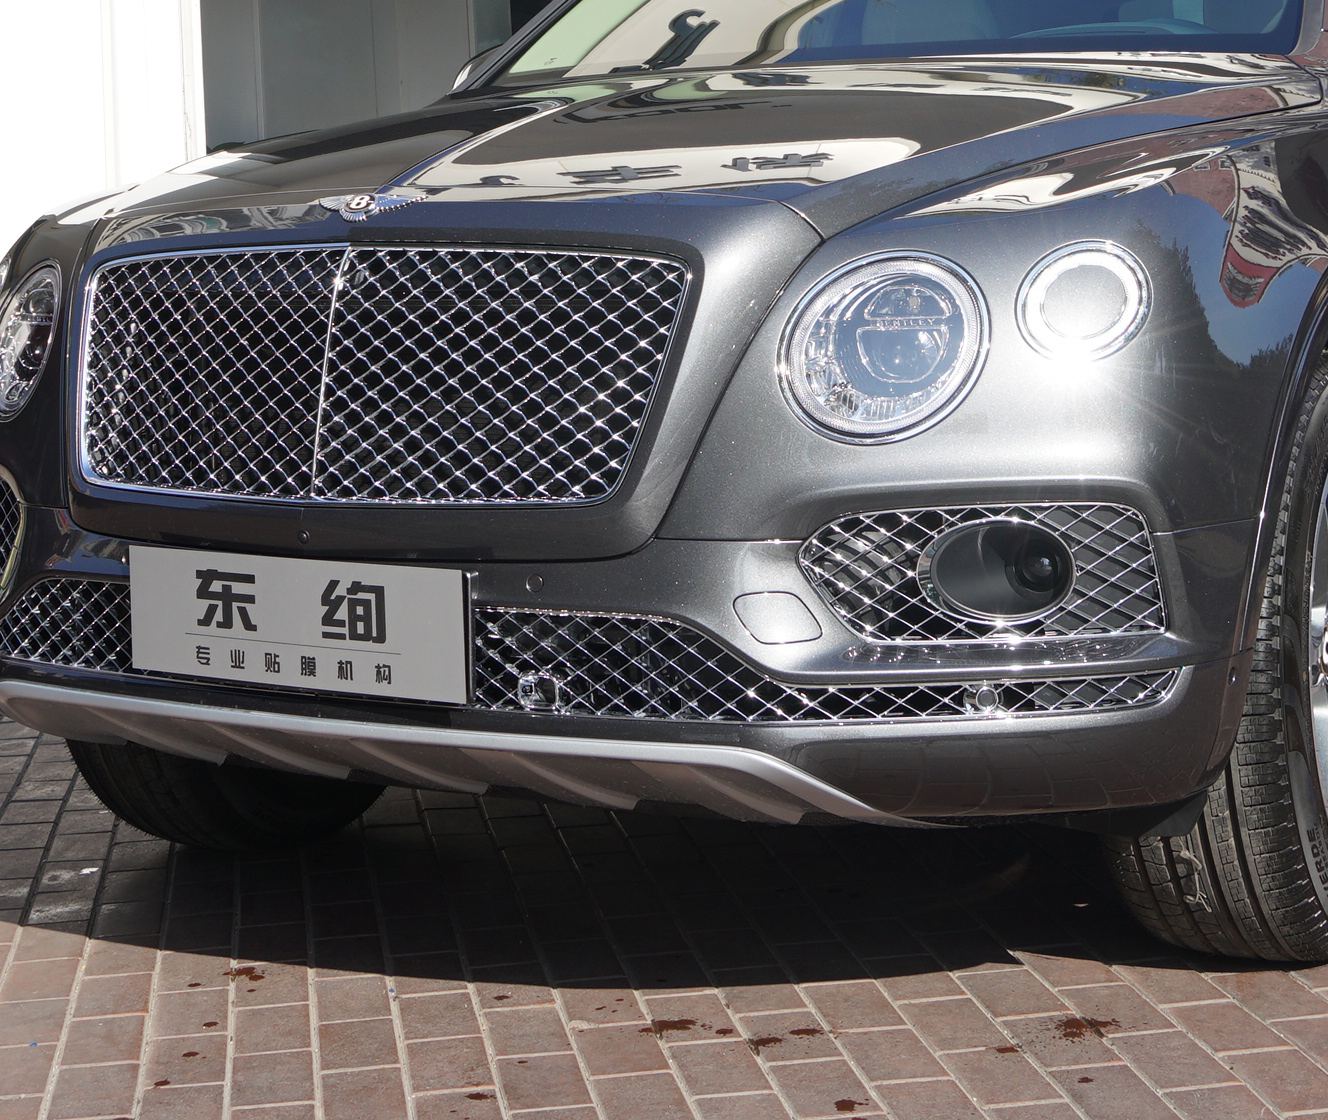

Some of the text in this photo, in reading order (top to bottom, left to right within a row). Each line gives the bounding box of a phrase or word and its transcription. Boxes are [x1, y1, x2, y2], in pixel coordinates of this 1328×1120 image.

[195, 568, 387, 644] 东绚
[195, 645, 393, 685] 专业贴膜机构
